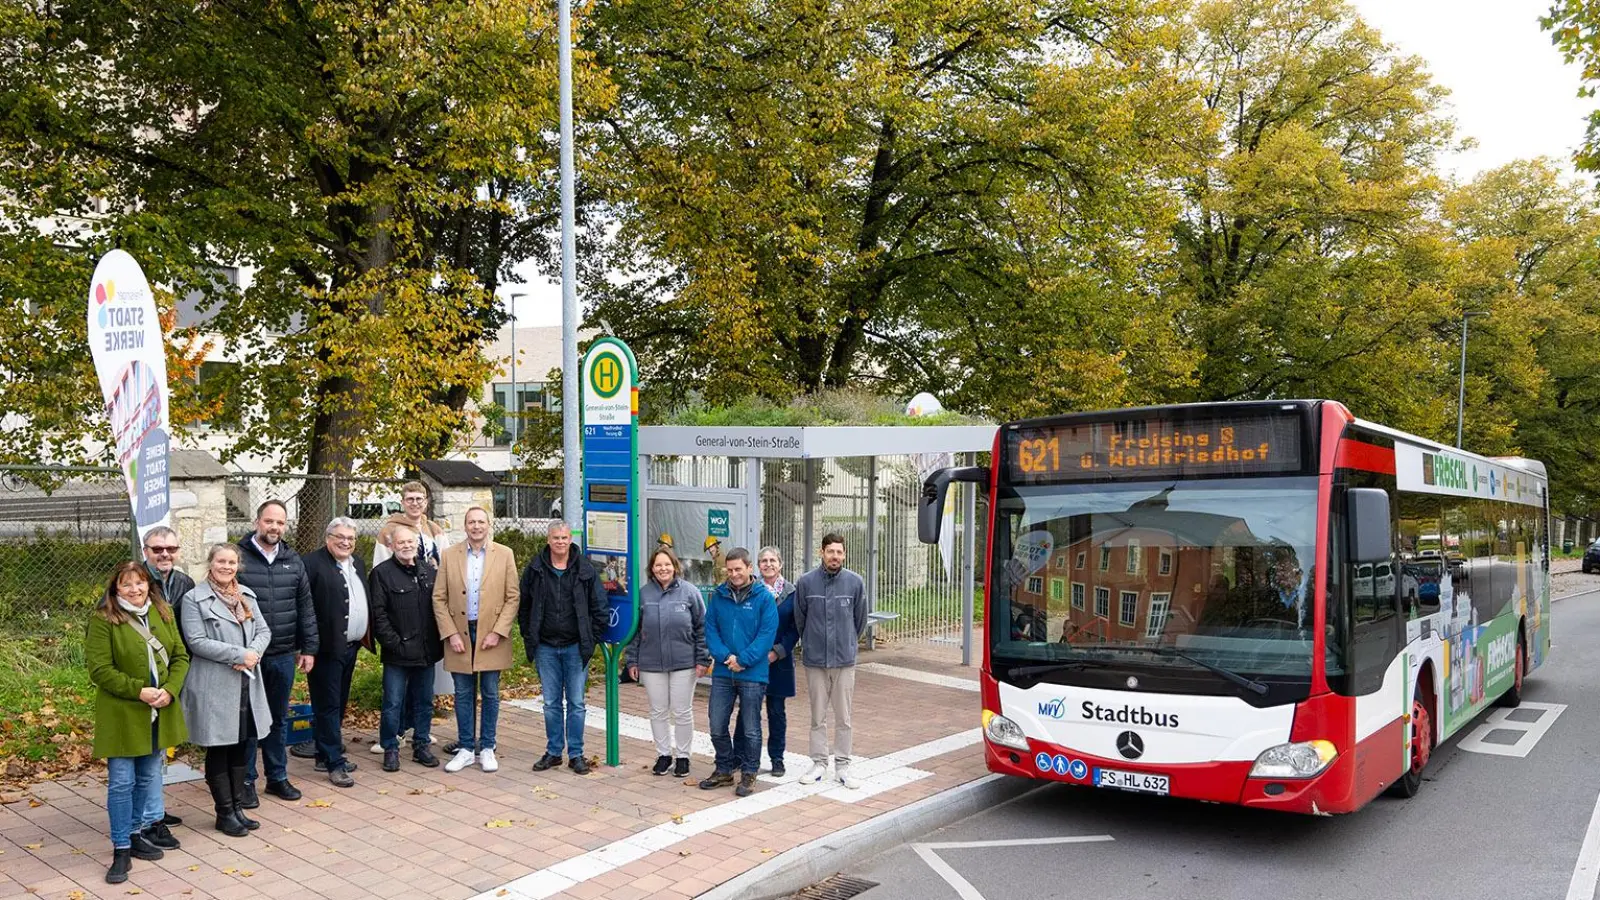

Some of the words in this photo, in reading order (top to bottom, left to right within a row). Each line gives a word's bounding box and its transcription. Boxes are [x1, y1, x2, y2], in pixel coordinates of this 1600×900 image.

[600, 362, 613, 388] H
[585, 426, 596, 436] 621
[696, 435, 800, 449] General-von-Stein-Straße
[1018, 436, 1059, 472] 621
[1109, 432, 1209, 450] Freising
[1080, 453, 1100, 469] ü.
[1109, 442, 1269, 468] Waldfriedhof
[1434, 454, 1468, 490] FRÖSCHL
[710, 516, 727, 525] WGV
[1081, 700, 1179, 728] Stadtbus
[1100, 770, 1116, 784] FS
[1124, 773, 1140, 787] HL
[1143, 776, 1167, 791] 632
